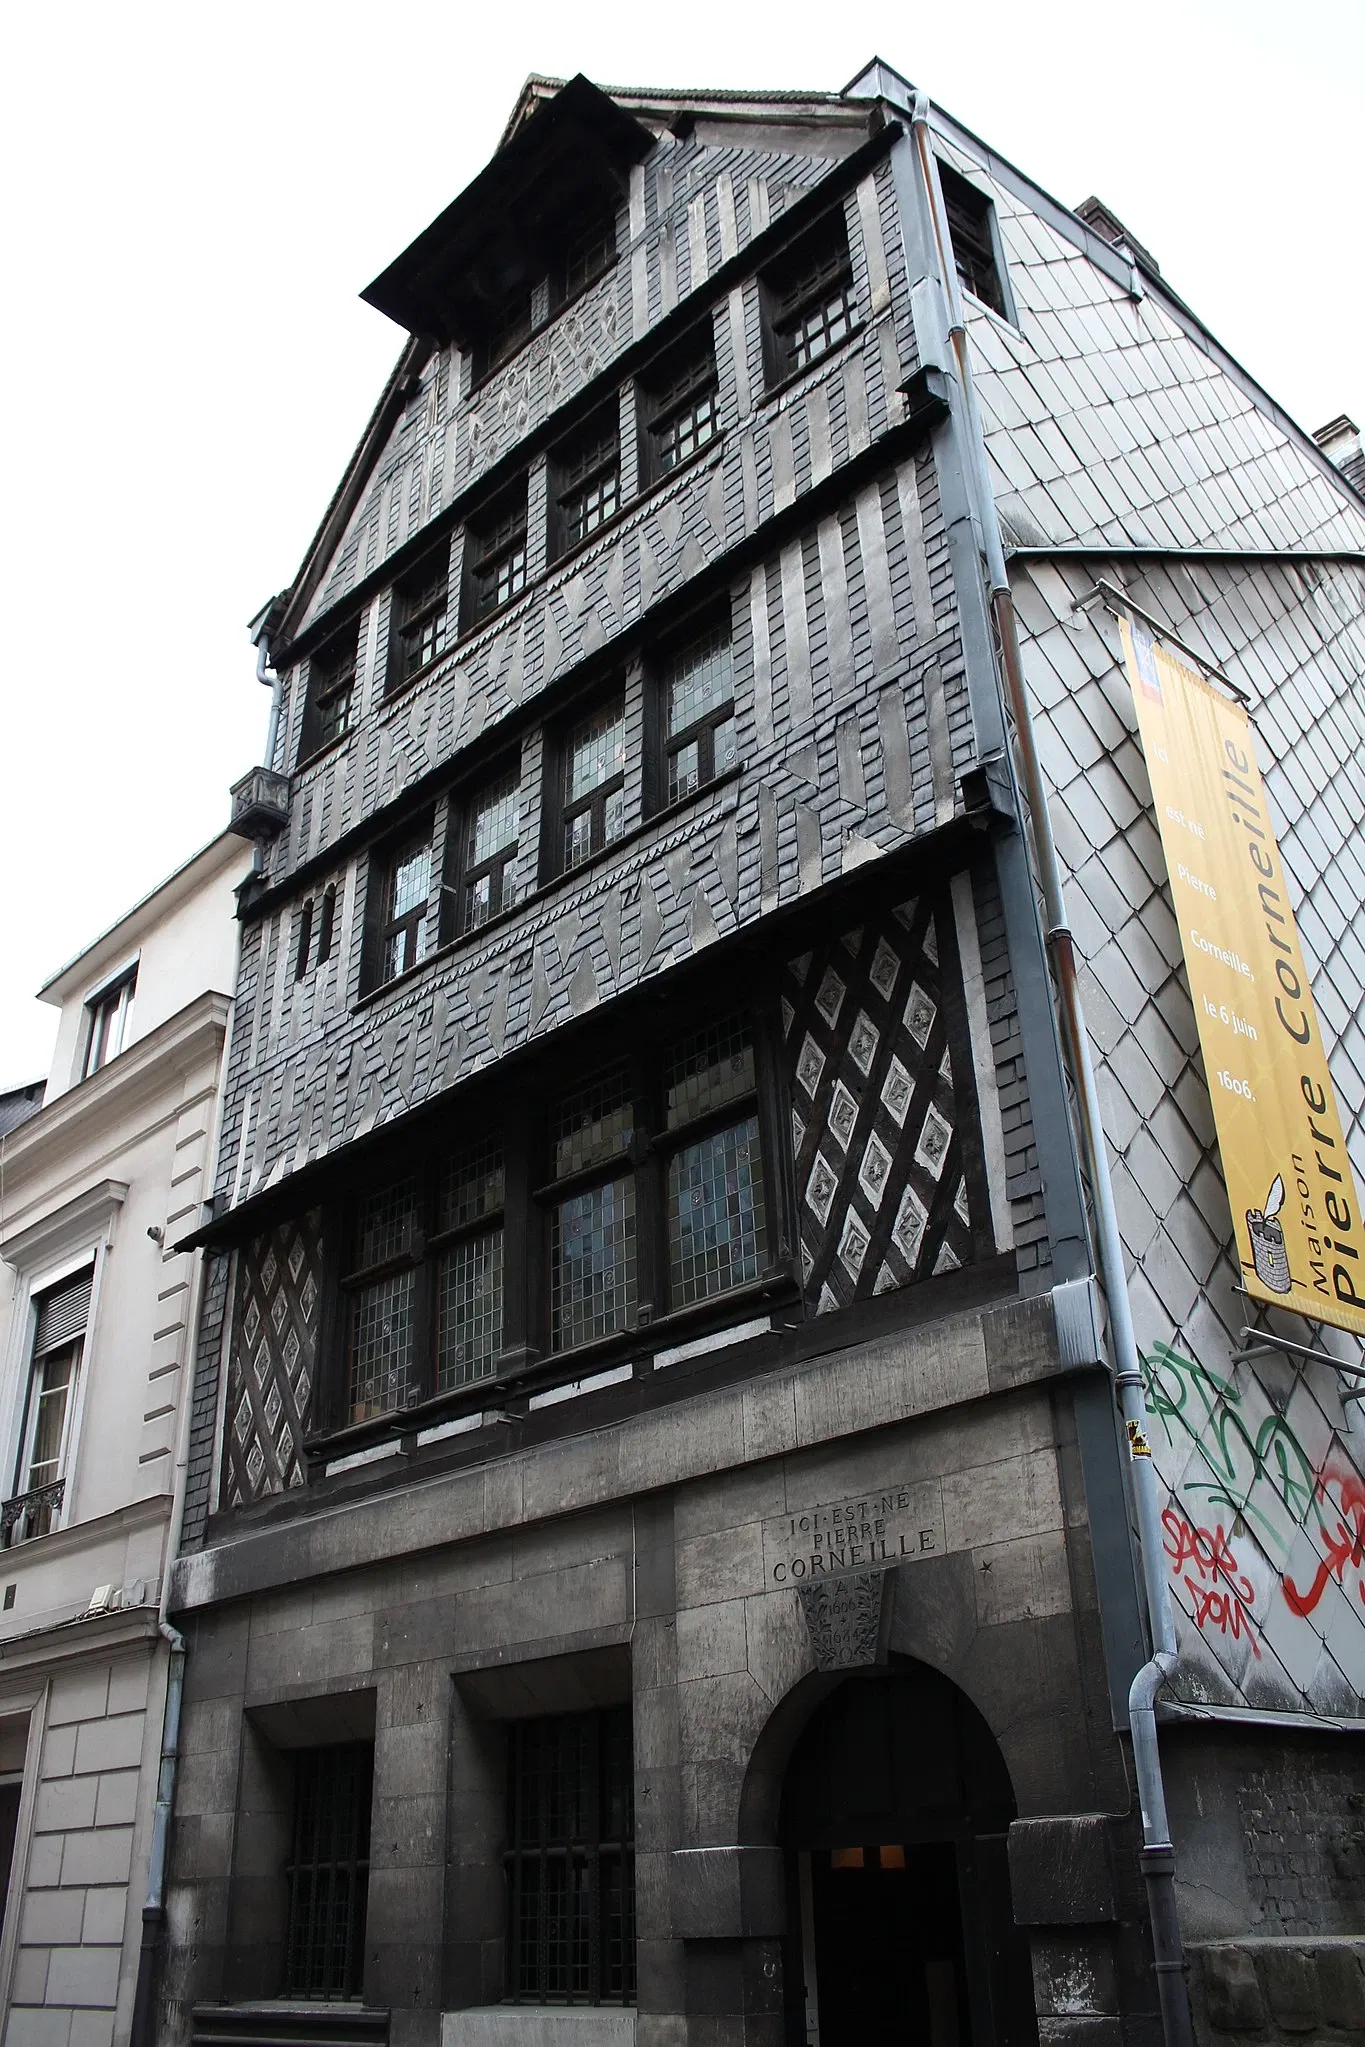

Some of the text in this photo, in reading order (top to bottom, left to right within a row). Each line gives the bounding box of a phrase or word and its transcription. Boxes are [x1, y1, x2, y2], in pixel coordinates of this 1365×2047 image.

[1165, 804, 1206, 840] est né
[1176, 862, 1217, 900] Pierre
[1190, 929, 1255, 982] Corneille,
[1202, 993, 1258, 1041] le 6 juin
[1221, 739, 1365, 1310] Pierre Corneille
[1216, 1071, 1257, 1103] 1606.
[1291, 1153, 1331, 1297] Maison
[790, 1514, 819, 1535] ICI
[832, 1502, 868, 1524] EST
[813, 1518, 886, 1550] PIERRE
[773, 1528, 936, 1582] CORNEILLE
